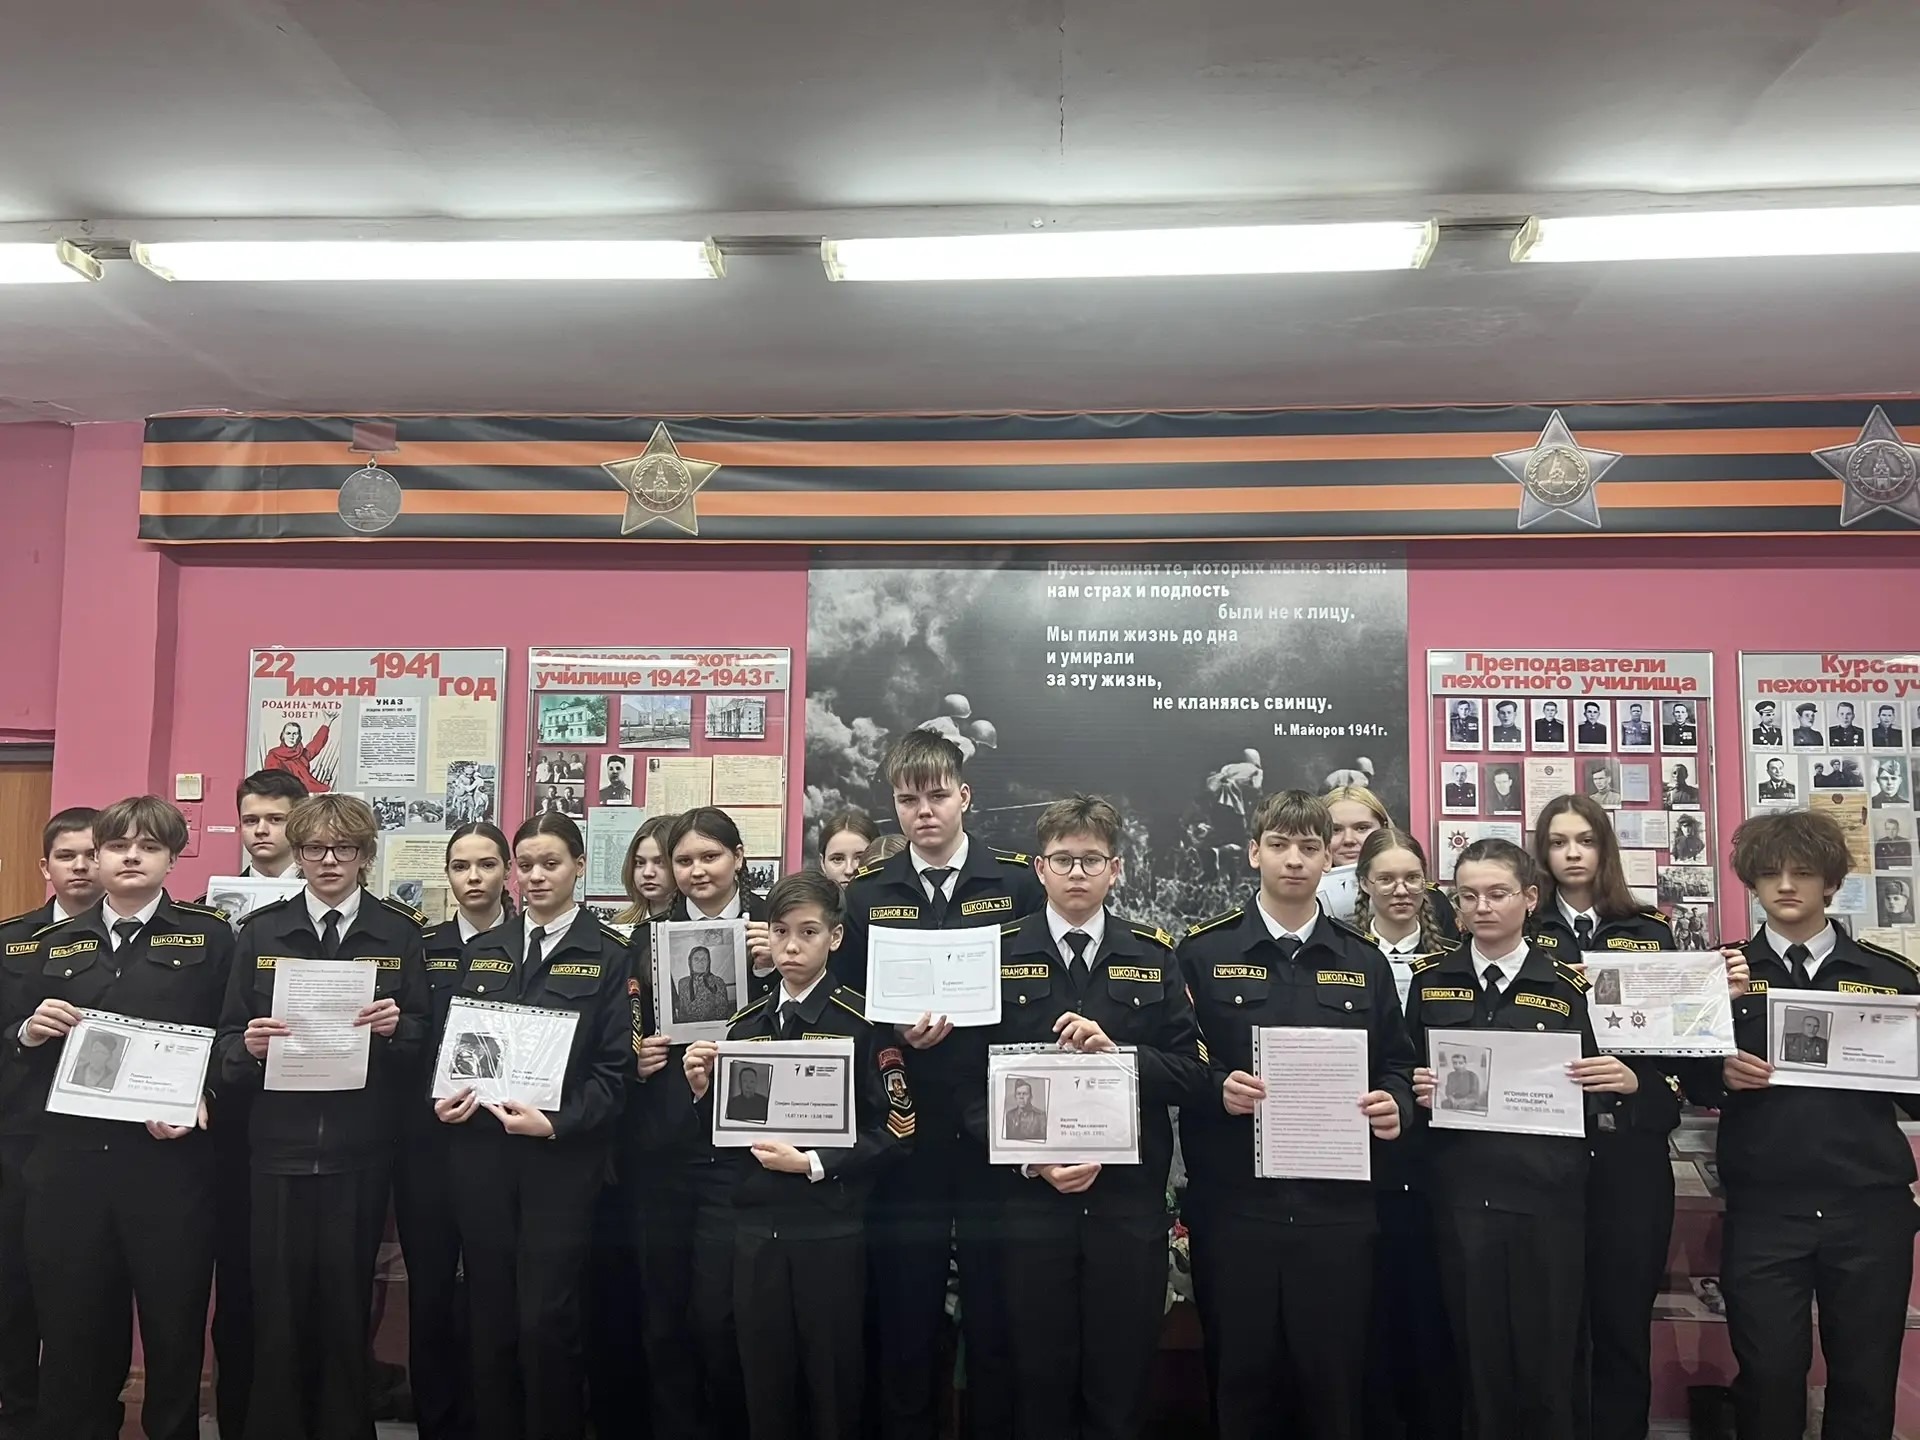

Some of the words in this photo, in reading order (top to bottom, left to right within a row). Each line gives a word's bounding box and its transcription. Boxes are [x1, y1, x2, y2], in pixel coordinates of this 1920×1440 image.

[1047, 561, 1096, 579] Пусть
[1100, 563, 1160, 575] помнят
[1164, 563, 1188, 578] те,
[1192, 562, 1264, 578] которых
[1269, 562, 1295, 574] мы
[1300, 562, 1321, 574] не
[1326, 561, 1387, 574] знаем:
[1047, 585, 1079, 597] нам
[1084, 585, 1131, 601] страх
[1136, 585, 1146, 597] и
[1150, 585, 1230, 600] подлость
[1218, 603, 1264, 619] были
[1268, 607, 1289, 619] не
[1294, 607, 1304, 619] к
[1307, 607, 1355, 623] лицу.
[1046, 626, 1073, 642] Мы
[1077, 629, 1119, 641] пили
[1124, 629, 1178, 642] жизнь
[1182, 629, 1203, 644] до
[1207, 629, 1238, 644] дна
[1046, 652, 1056, 664] и
[1060, 652, 1135, 667] умирали
[1465, 653, 1667, 675] Преподаватели
[254, 652, 295, 677] 22
[286, 674, 377, 697] июня
[370, 652, 440, 679] 1941
[439, 676, 497, 701] год
[536, 671, 642, 688] училище
[1046, 674, 1066, 686] за
[1070, 674, 1097, 690] эту
[1101, 674, 1162, 690] жизнь,
[1441, 674, 1572, 689] пехотного
[1580, 675, 1697, 693] училища
[1758, 679, 1889, 693] пехотного
[262, 700, 342, 710] РОДИНА-МАТЬ
[1152, 697, 1173, 710] не
[1178, 697, 1260, 710] кланяясь
[1264, 697, 1332, 713] свинцу.
[281, 710, 319, 719] ЗОВЕТ!
[1274, 724, 1287, 736] Н.
[1290, 723, 1345, 738] Майоров
[1348, 723, 1388, 736] 1941г.
[872, 908, 901, 917] БУДАНОВ
[963, 902, 993, 913] ШКОЛА
[153, 936, 184, 944] ШКОЛА
[1609, 939, 1639, 950] ШКОЛА
[552, 966, 580, 974] ШКОЛА
[1000, 967, 1029, 976] ИВАНОВ
[1111, 967, 1140, 978] ШКОЛА
[1217, 967, 1247, 976] ЧИЧАГОВ
[1319, 972, 1348, 982] ШКОЛА
[1517, 995, 1547, 1007] ШКОЛА
